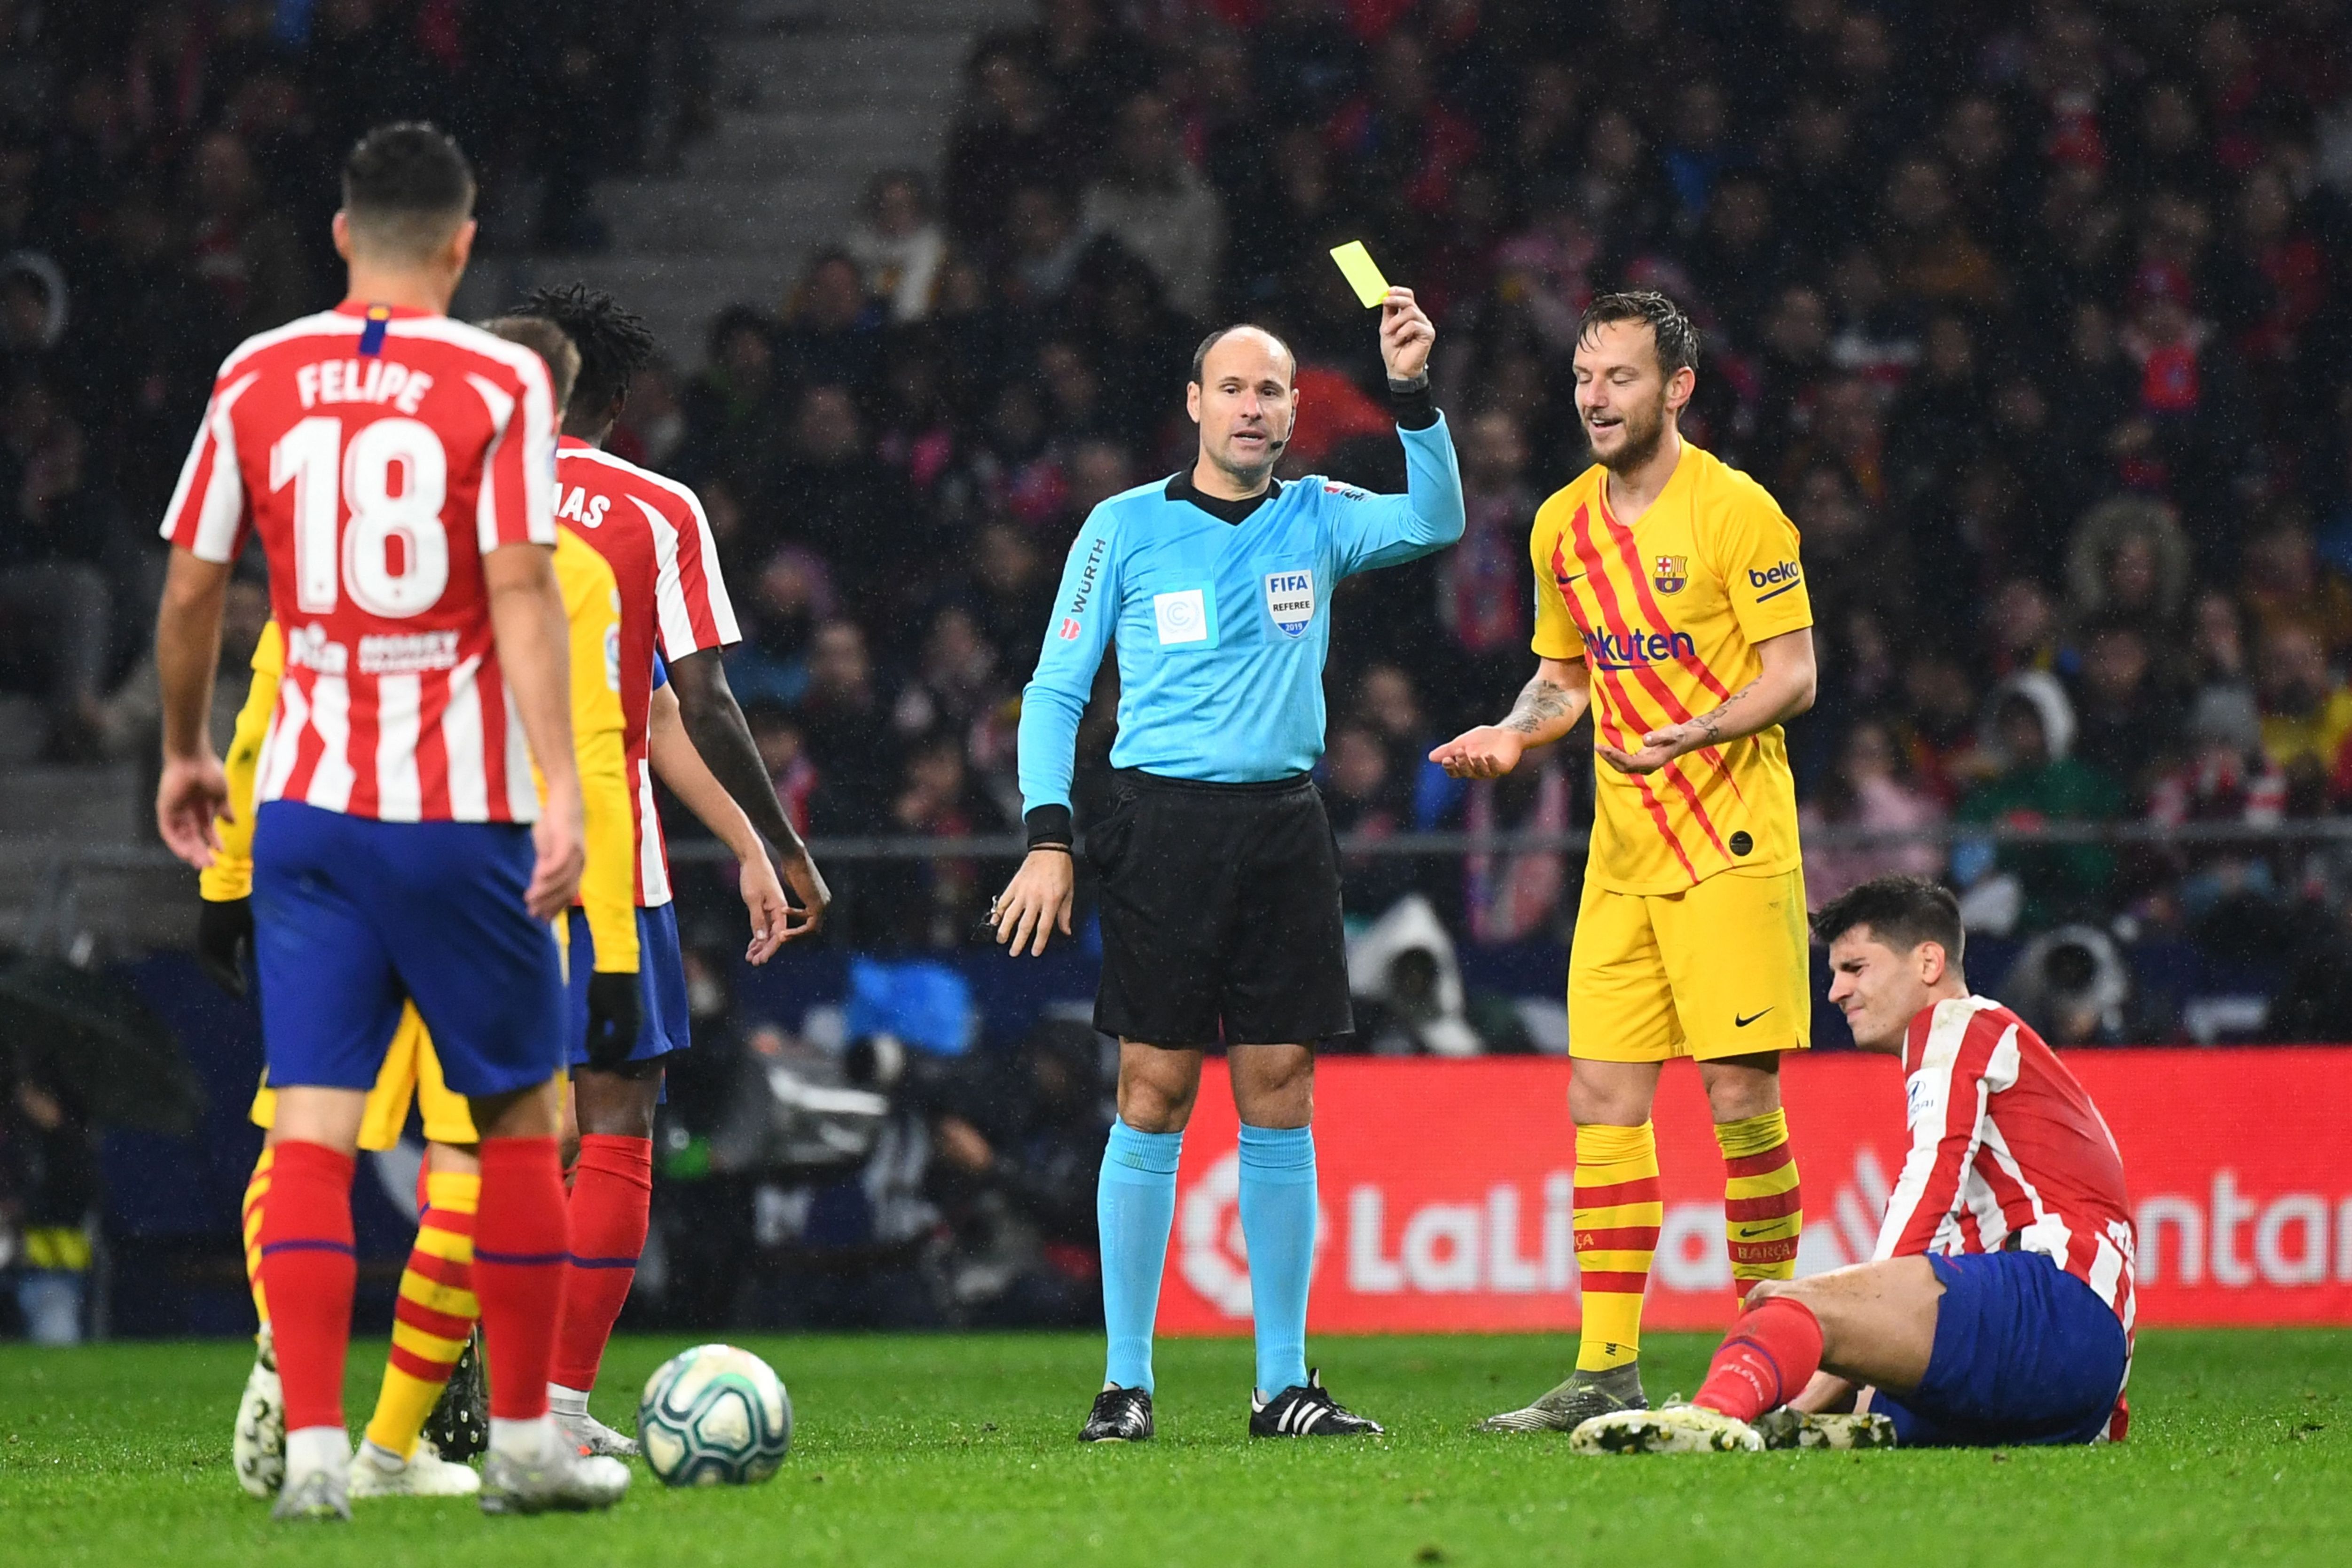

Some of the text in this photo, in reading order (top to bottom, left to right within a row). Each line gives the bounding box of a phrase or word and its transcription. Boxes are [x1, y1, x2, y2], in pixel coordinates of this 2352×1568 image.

[296, 359, 433, 415] FELIPE
[269, 416, 449, 619] 18
[1071, 538, 1106, 613] WÜRTH
[1270, 575, 1308, 593] FIFA
[1748, 560, 1799, 588] beko
[1273, 600, 1311, 612] REFEREE
[1285, 622, 1303, 632] 2019
[1579, 625, 1695, 661] kuten
[1347, 1170, 1726, 1300] LaLia
[1738, 1242, 1790, 1261] BARÇA
